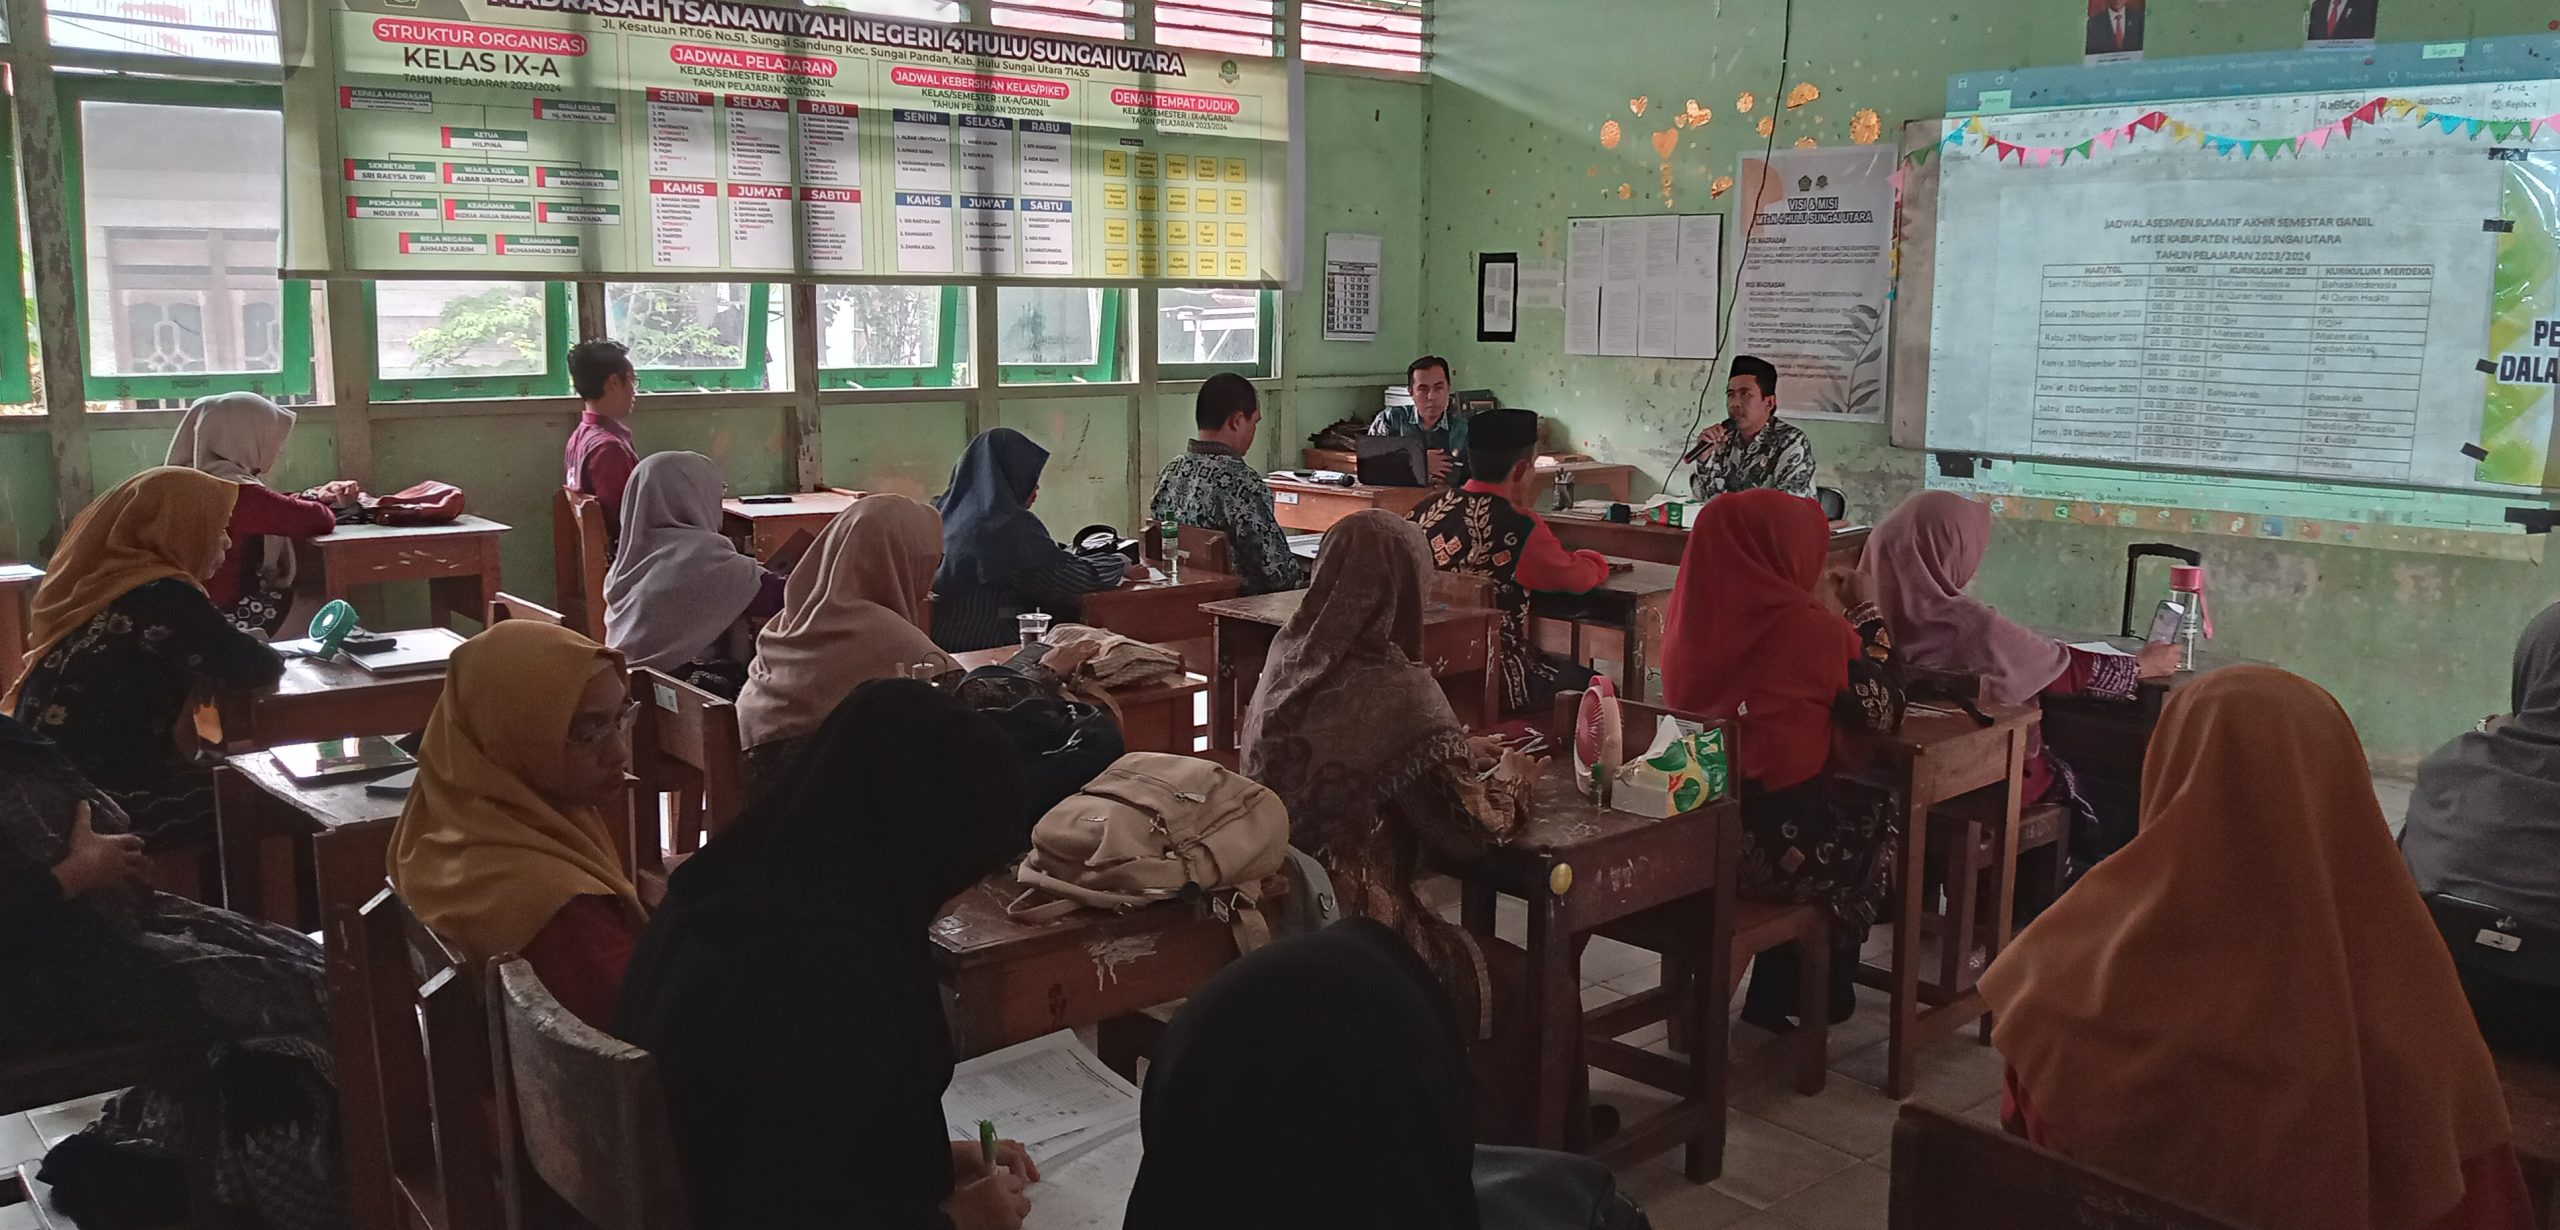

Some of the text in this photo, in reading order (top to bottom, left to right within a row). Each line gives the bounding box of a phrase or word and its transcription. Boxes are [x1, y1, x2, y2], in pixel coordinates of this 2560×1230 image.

[378, 23, 585, 53] STRUKTUR ORGANISASI
[672, 1, 847, 39] TSANAWIYAH
[853, 20, 941, 48] NEGERI
[945, 31, 962, 50] 4
[967, 34, 1027, 57] HULU
[1032, 41, 1112, 67] SUNGAI
[1118, 51, 1185, 75] UTARA
[602, 19, 1090, 78] Jl. Kesatuan RT.06 No.51, Sungai Sandung Kec. Sungai Pandan, Kab. Hulu Sungai Utara 71455
[403, 46, 560, 77] KELAS IX-A
[675, 48, 833, 75] JADWAL PELAJARAN
[680, 66, 834, 87] KELAS/SEMESTER IX-A/GANJIL
[404, 74, 562, 92] TAHUN PELAJARAN 2023/2024
[692, 78, 826, 98] TAHUN PELAJARAN 2023/2024
[896, 71, 1066, 97] JADWAL KEBERSIHAN KELAS/PIKET
[2508, 84, 2526, 92] Find
[385, 91, 430, 100] MADRASAH
[660, 91, 699, 104] SENIN
[922, 89, 1050, 107] KELAS/SEMESTER IX-A/GANJIL
[733, 97, 781, 110] SELASA
[1115, 92, 1235, 112] DENAH TEMPAT DUDUK
[2506, 100, 2537, 110] Replace
[811, 104, 845, 115] RABU
[932, 100, 1044, 117] TAHUN PELAJARAN 2023/2024
[1122, 108, 1187, 119] KELAS/SEMESTER
[904, 112, 937, 123] SENIN
[965, 117, 1006, 128] SELASA
[1031, 121, 1060, 132] RABU
[1132, 117, 1228, 131] TAHUN PELAJARAN 2023/2024
[473, 131, 499, 139] KETUA
[368, 162, 416, 171] SEKRETARIS
[464, 166, 516, 175] WAKIL KETUA
[663, 182, 704, 195] KAMIS
[738, 186, 783, 198] JUM'AT
[811, 190, 851, 201] SABTU
[906, 195, 941, 206] KAMIS
[368, 199, 423, 208] PENGAJARAN
[969, 197, 1007, 208] JUM'AT
[1030, 201, 1063, 211] SABTU
[1788, 197, 1839, 211] VISI & MISI
[1786, 211, 1873, 225] HULU SUNGAI UTARA
[2243, 218, 2276, 227] AKHIR
[2336, 217, 2374, 227] GANJIL
[519, 237, 562, 245] KEAMANAN
[2131, 235, 2342, 244] MTS SE KABUPATEN HULU SUNGAI UTARA
[2155, 251, 2311, 261] TAHUN PELAJARAN 2023/2024
[2166, 266, 2198, 274] WAKTU
[2229, 267, 2283, 275] KURIKULUM
[2325, 267, 2431, 276] KURIKULUM MERDEKA
[2533, 320, 2560, 347] PE
